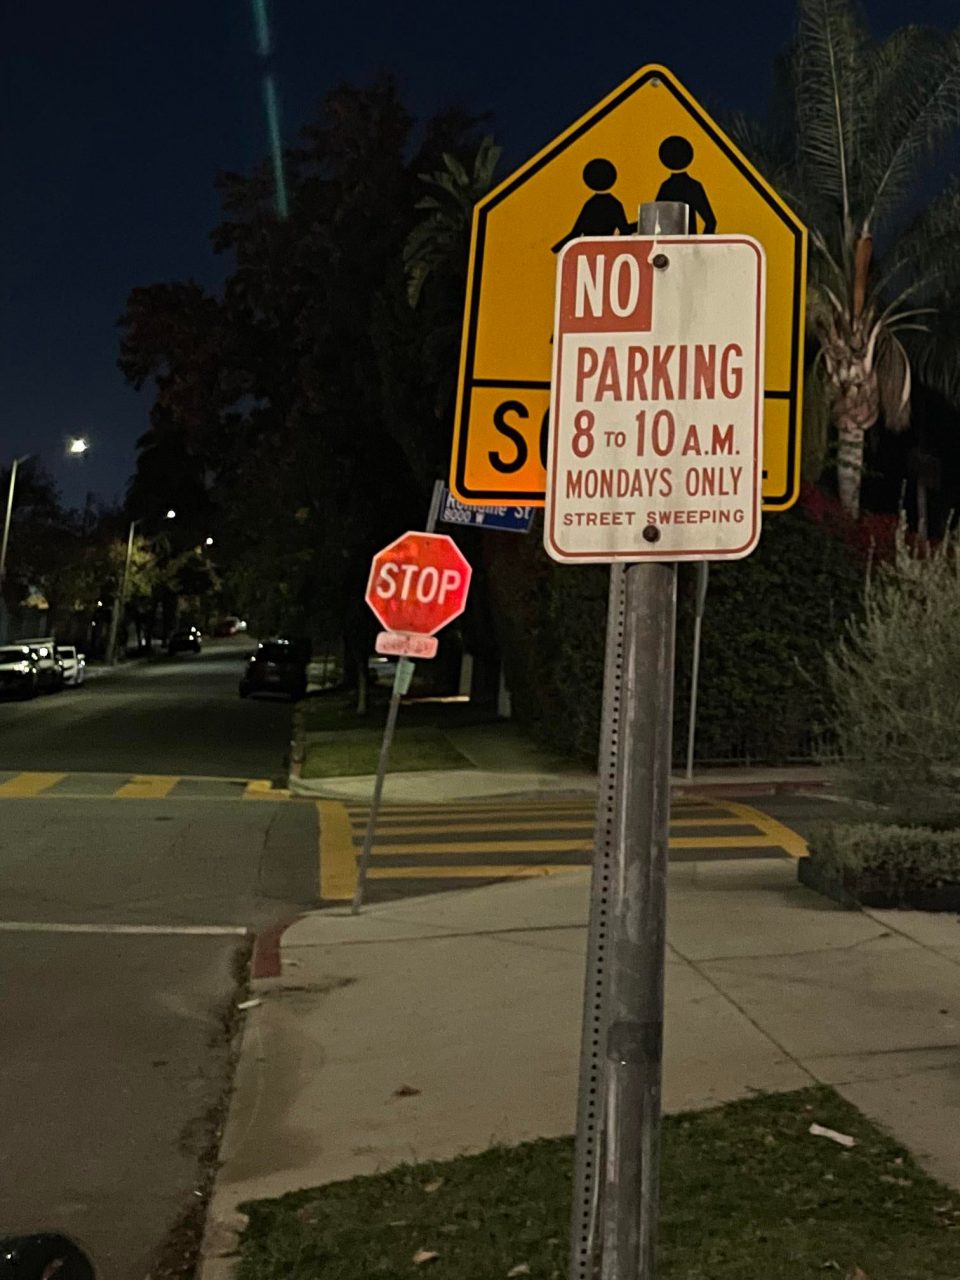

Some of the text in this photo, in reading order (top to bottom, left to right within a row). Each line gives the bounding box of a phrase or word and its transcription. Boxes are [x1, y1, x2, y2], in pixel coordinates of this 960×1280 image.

[574, 253, 641, 319] NO
[575, 343, 744, 403] PARKING
[571, 409, 596, 459] 8
[604, 431, 627, 448] TO
[565, 466, 744, 499] MONDAYS ONLY
[562, 509, 745, 527] STREET SWEEPING
[375, 562, 462, 605] STOP
